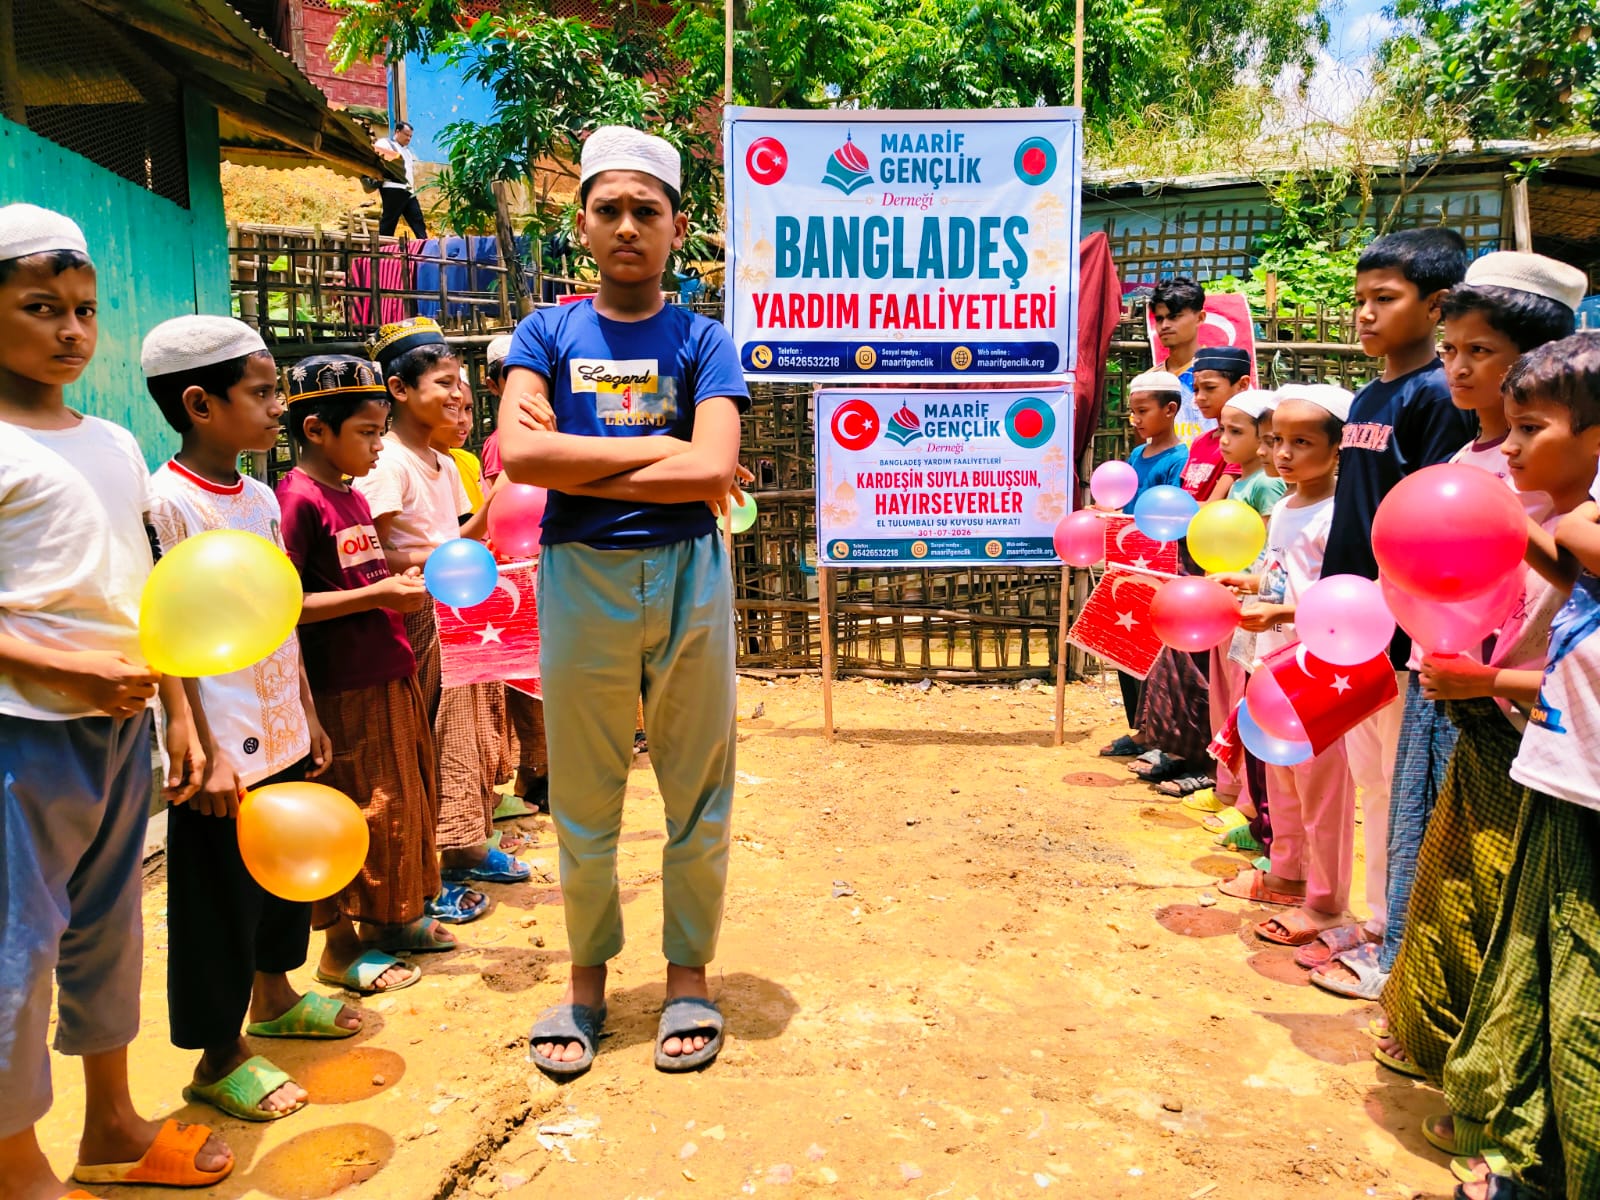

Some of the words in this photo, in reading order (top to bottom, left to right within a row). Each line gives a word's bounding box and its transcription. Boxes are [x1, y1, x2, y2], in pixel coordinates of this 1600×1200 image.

[880, 129, 966, 154] MAARİF
[879, 152, 982, 190] GENÇLİK
[881, 192, 934, 211] Derneği
[775, 215, 1029, 290] BANGLADEŞ
[752, 292, 859, 329] YARDIM
[869, 285, 1057, 330] FAALİYETLERİ
[777, 356, 840, 367] 05426532218
[881, 357, 934, 368] maarifgenclik
[977, 357, 1045, 368] maarifgenclik.org
[578, 365, 651, 389] Legend
[924, 400, 990, 419] MAARİF
[924, 417, 1000, 442] GENÇLİK
[927, 442, 964, 454] Derneği
[879, 459, 922, 467] BANGLADEŞ
[924, 458, 951, 466] YARDIM
[953, 456, 1001, 465] FAALİYETLERİ
[857, 468, 923, 492] KARDEŞİN
[927, 471, 969, 488] SUYLA
[972, 470, 1041, 490] BULUŞSUN,
[875, 491, 1023, 515] HAYIRSEVERLER
[876, 519, 886, 528] EL
[887, 519, 934, 527] TULUMBALI
[950, 518, 983, 526] KUYUSU
[986, 518, 1021, 526] HAYRATI
